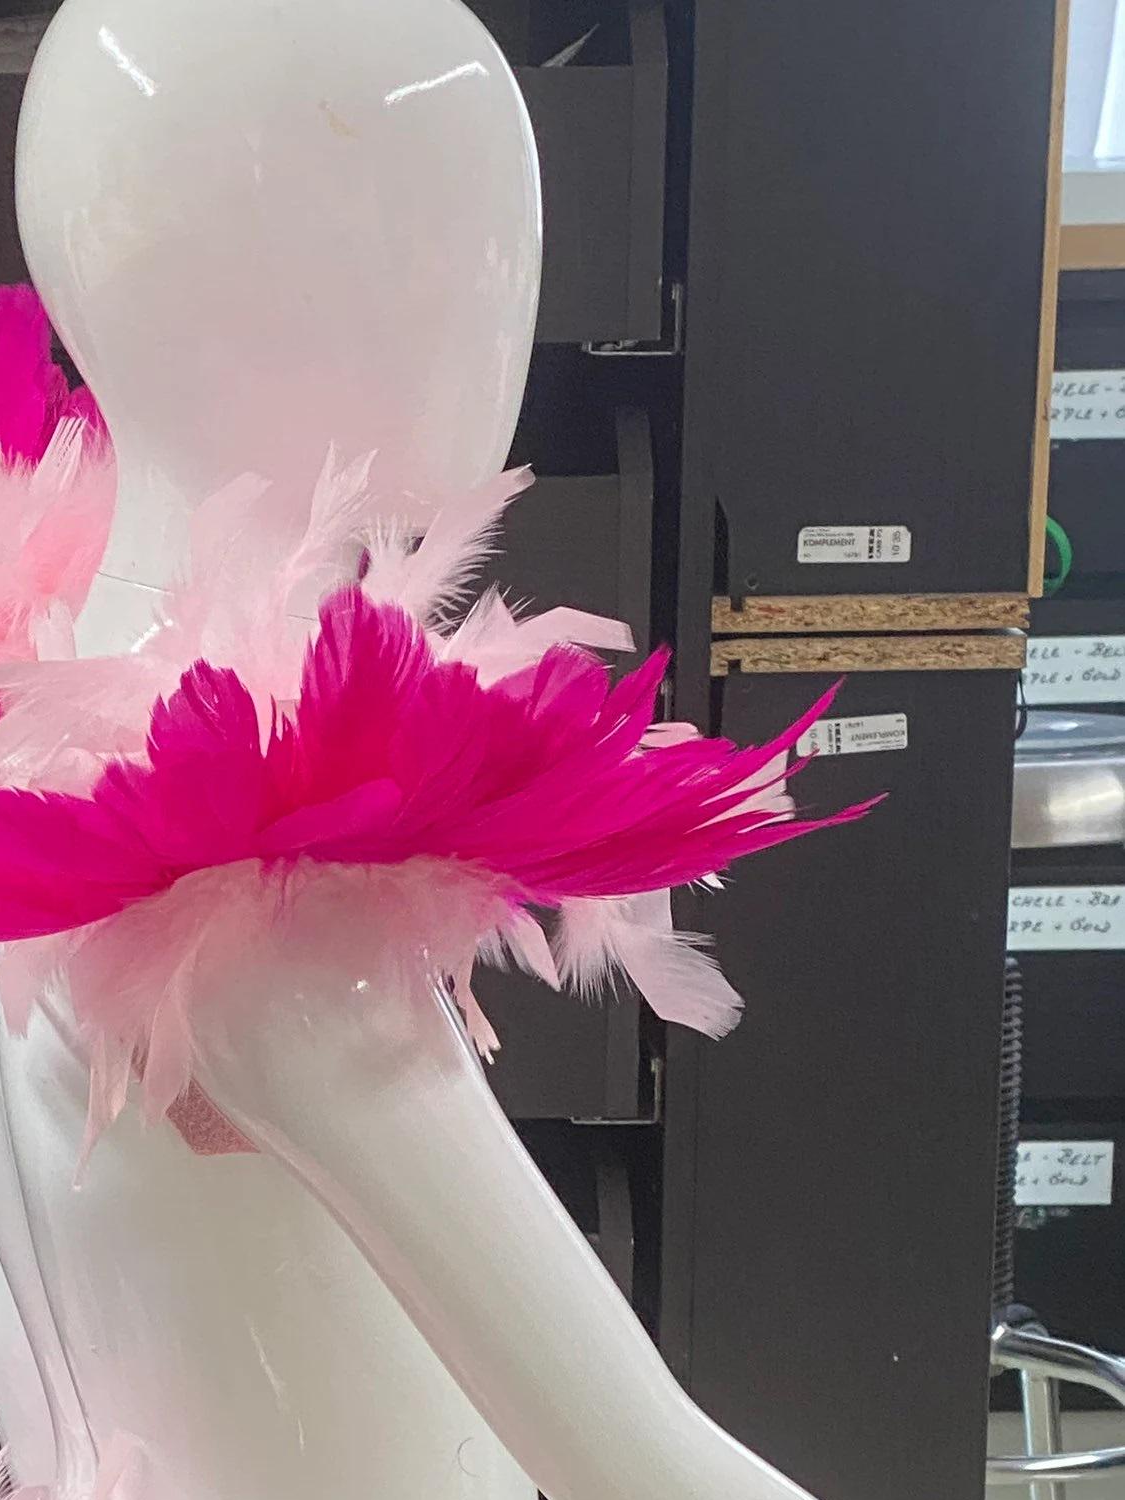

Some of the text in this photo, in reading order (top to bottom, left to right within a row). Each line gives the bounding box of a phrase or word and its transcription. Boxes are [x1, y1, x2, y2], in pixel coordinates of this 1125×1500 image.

[803, 538, 856, 547] KOMPLEMENT
[1087, 642, 1125, 659] BEL
[851, 729, 906, 742] KOMPLEMENT
[1056, 1147, 1107, 1166] BELT
